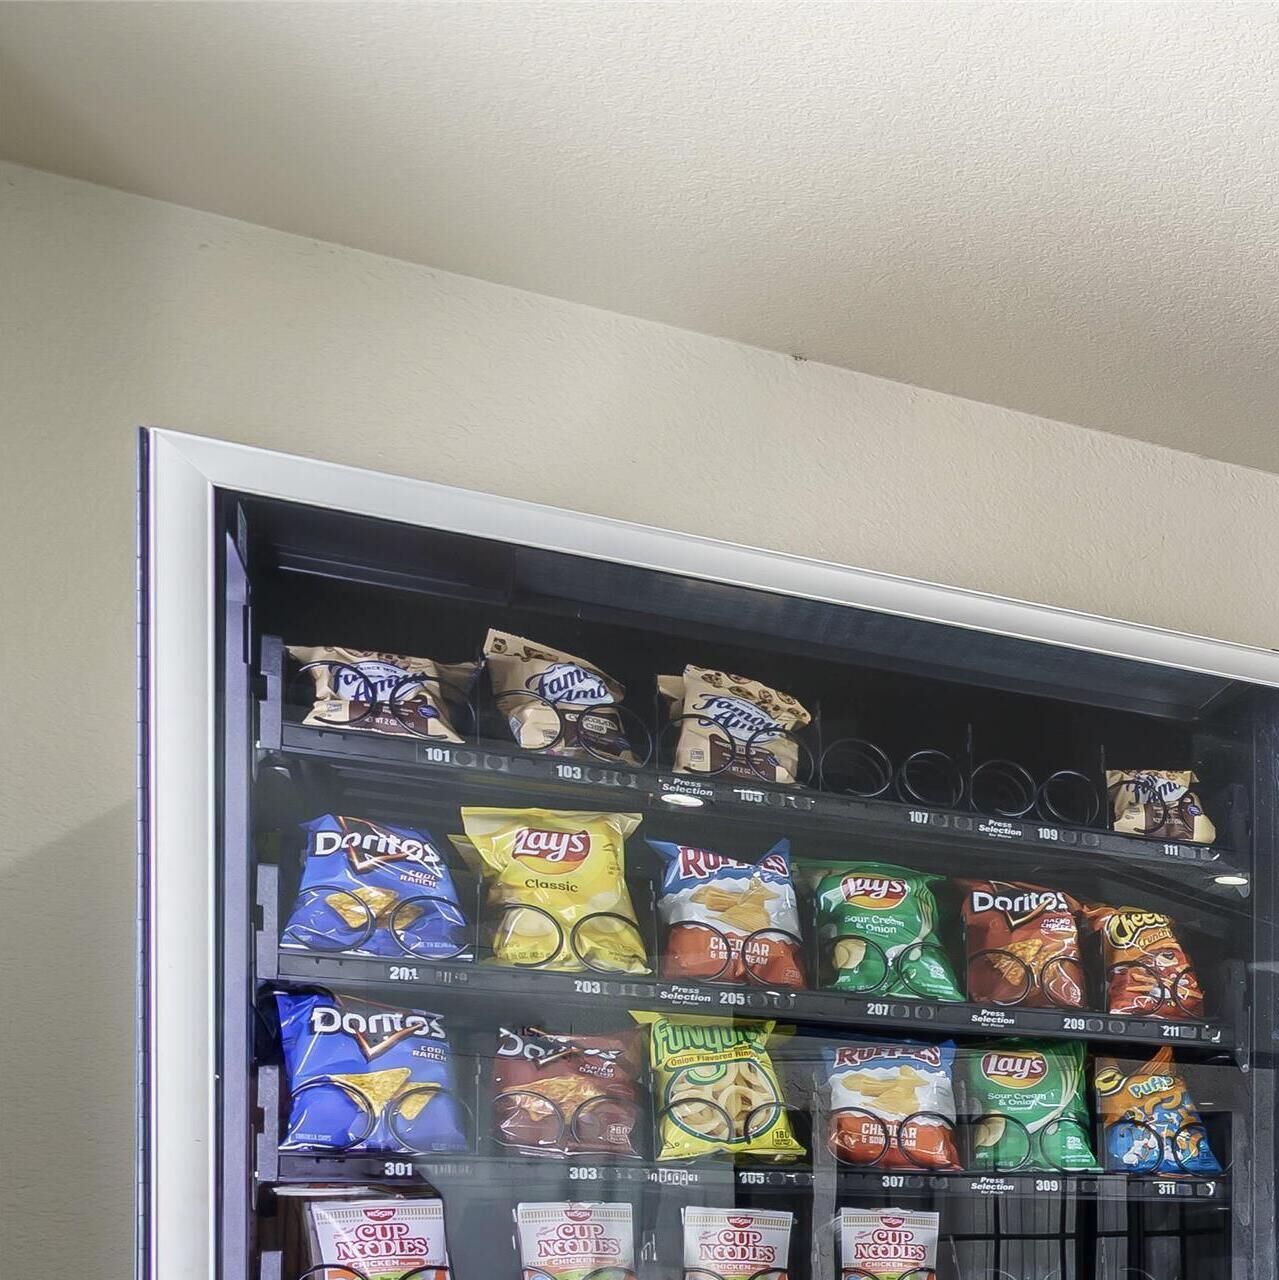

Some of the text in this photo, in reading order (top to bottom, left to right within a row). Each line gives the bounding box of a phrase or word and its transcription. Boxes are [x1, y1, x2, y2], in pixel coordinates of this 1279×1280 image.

[425, 747, 450, 762] 101
[556, 764, 582, 780] 103
[673, 777, 702, 788] Press
[662, 783, 713, 797] Selection
[909, 810, 929, 824] 107
[978, 824, 1022, 836] Selection
[988, 819, 1012, 829] Press
[1037, 828, 1058, 840] 109
[314, 831, 441, 862] Doritos
[1163, 844, 1179, 856] 111
[525, 878, 579, 893] Classic
[972, 890, 1068, 913] Doritos
[865, 923, 897, 935] Onion
[574, 981, 600, 994] 203
[671, 985, 700, 995] Press
[660, 991, 711, 1004] Selection
[720, 992, 745, 1006] 205
[867, 1003, 889, 1016] 207
[981, 1009, 1005, 1018] Press
[312, 1007, 446, 1039] Doritos
[971, 1014, 1015, 1025] Selection
[1064, 1017, 1085, 1030] 209
[1163, 1025, 1180, 1037] 211
[413, 1050, 447, 1061] RANCH
[1128, 1075, 1175, 1098] Puffs
[385, 1163, 413, 1176] 301
[569, 1167, 597, 1180] 303
[882, 1176, 904, 1188] 307
[971, 1183, 1015, 1192] Selection
[980, 1177, 1005, 1185] Press
[1036, 1180, 1058, 1191] 309
[1158, 1183, 1175, 1194] 311
[355, 1223, 410, 1242] CUP
[556, 1224, 605, 1239] CUP
[718, 1230, 763, 1246] CUP
[871, 1229, 914, 1244] CUP
[336, 1238, 428, 1261] NOODLES
[538, 1238, 621, 1257] NOODLES
[698, 1244, 776, 1263] NOODLES
[854, 1243, 926, 1261] NOODLES
[552, 1257, 596, 1266] CHICKEN
